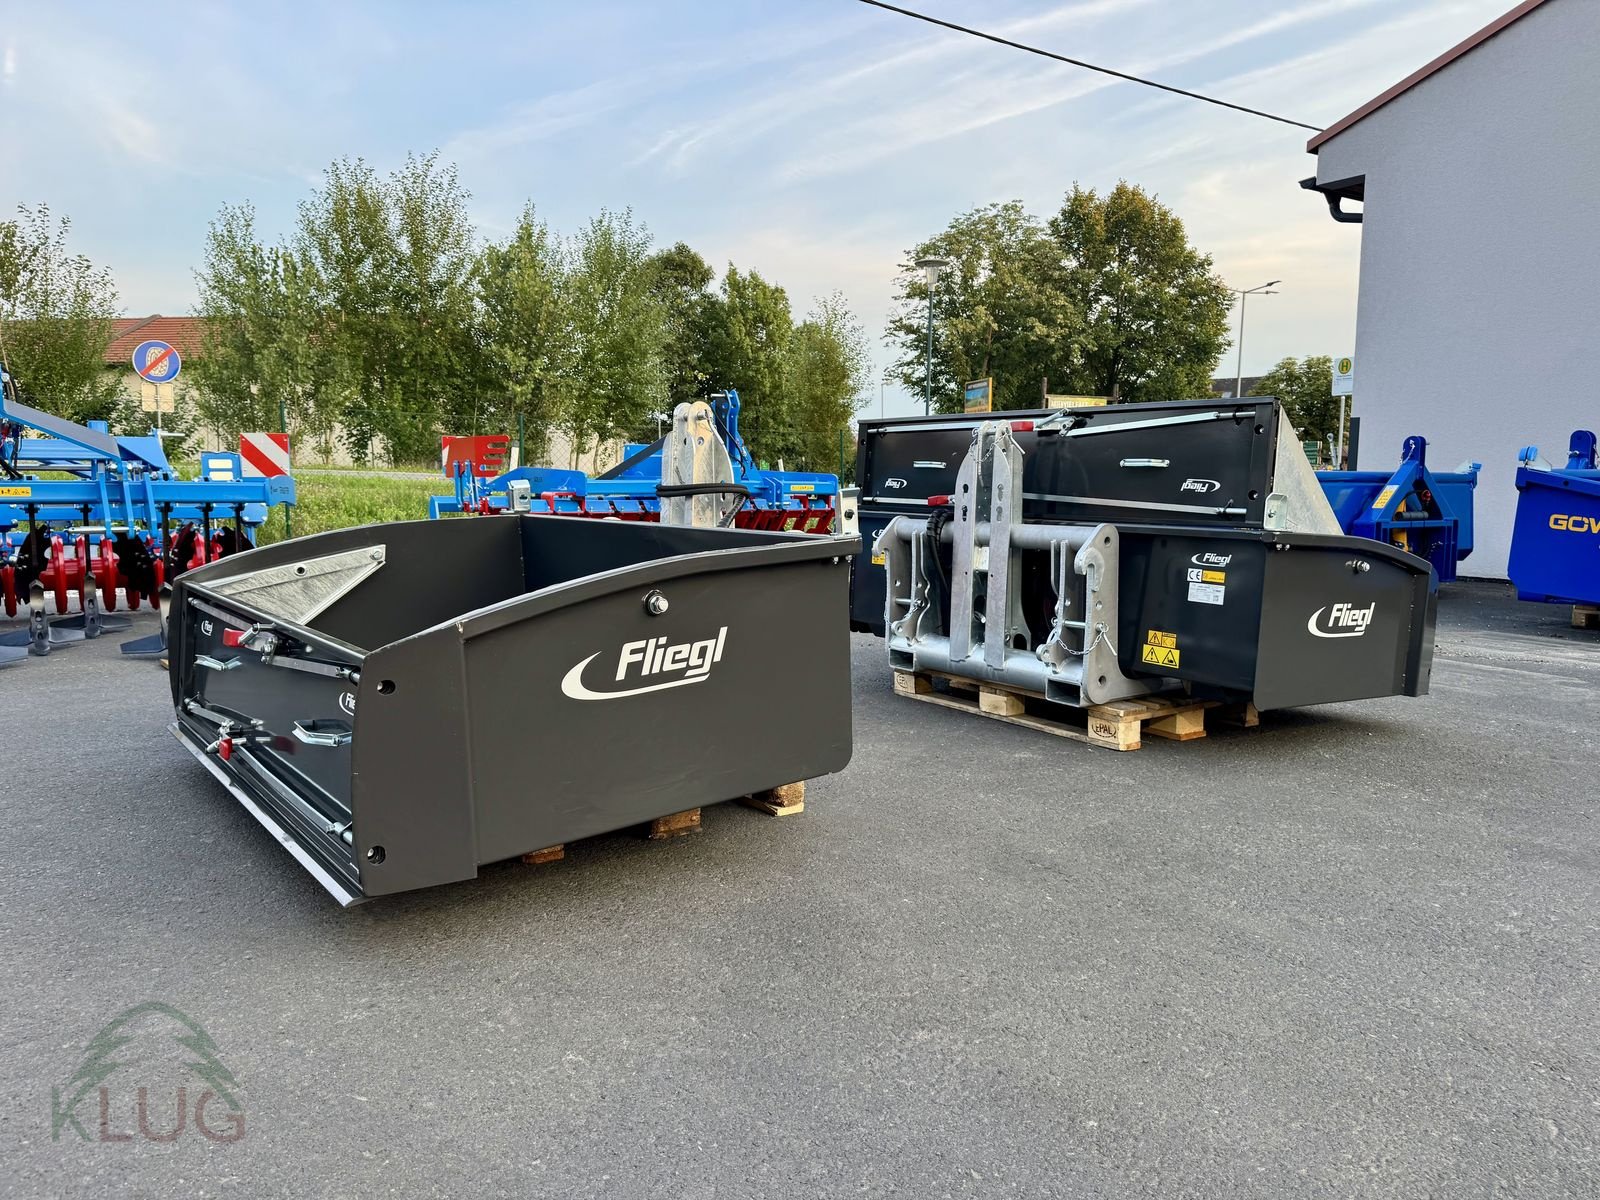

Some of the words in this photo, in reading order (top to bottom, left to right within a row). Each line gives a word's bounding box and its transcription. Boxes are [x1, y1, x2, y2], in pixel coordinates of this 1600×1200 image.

[1341, 361, 1349, 371] H
[1180, 481, 1209, 492] Fliegl
[1203, 552, 1232, 565] Fliegl
[1189, 570, 1202, 580] CE
[1328, 602, 1376, 631] Fliegl
[615, 626, 728, 681] Fliegl
[1095, 723, 1113, 735] EPAL
